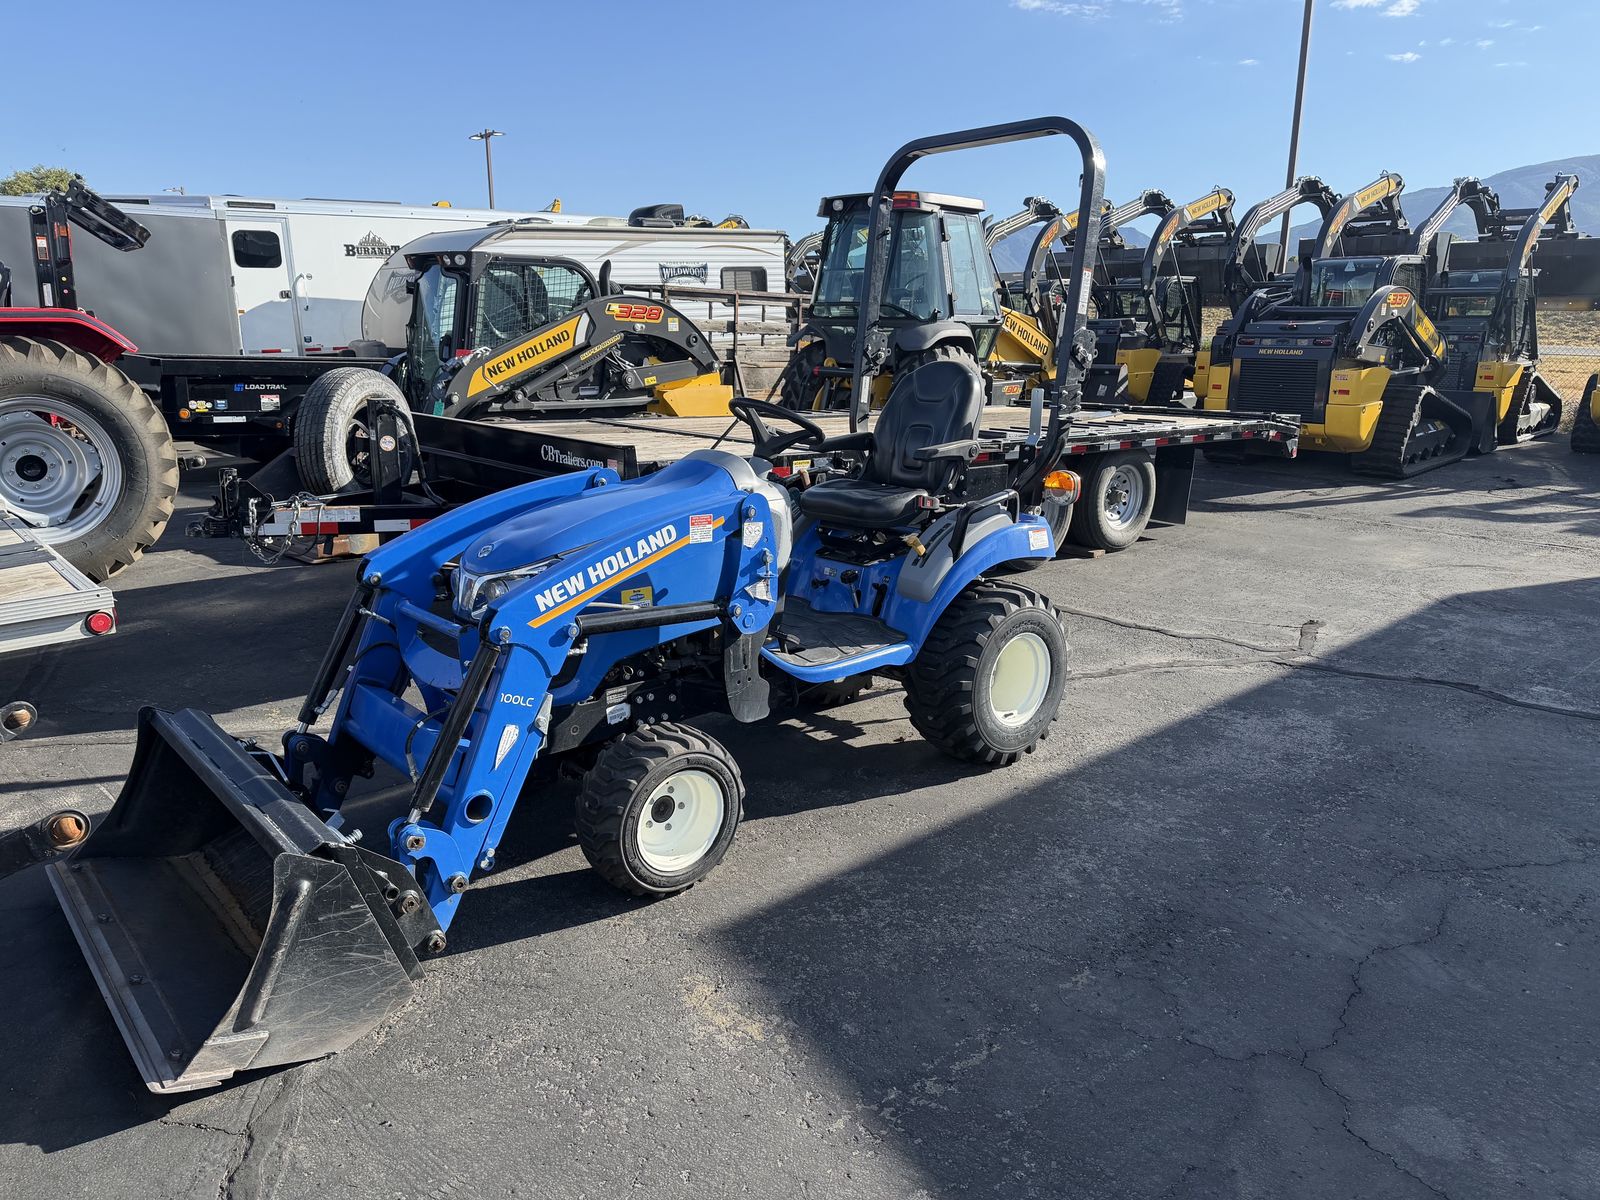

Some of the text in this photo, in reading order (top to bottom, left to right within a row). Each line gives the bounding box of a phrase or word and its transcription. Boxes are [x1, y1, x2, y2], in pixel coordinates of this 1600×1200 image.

[662, 267, 705, 280] WILDWOOD
[1004, 315, 1049, 356] EW HOLLAND
[486, 329, 570, 378] NEW HOLLAND
[540, 444, 604, 468] CBTrailers.com
[534, 571, 586, 612] NEW
[586, 524, 677, 585] HOLLAND
[500, 692, 535, 707] 100LC
